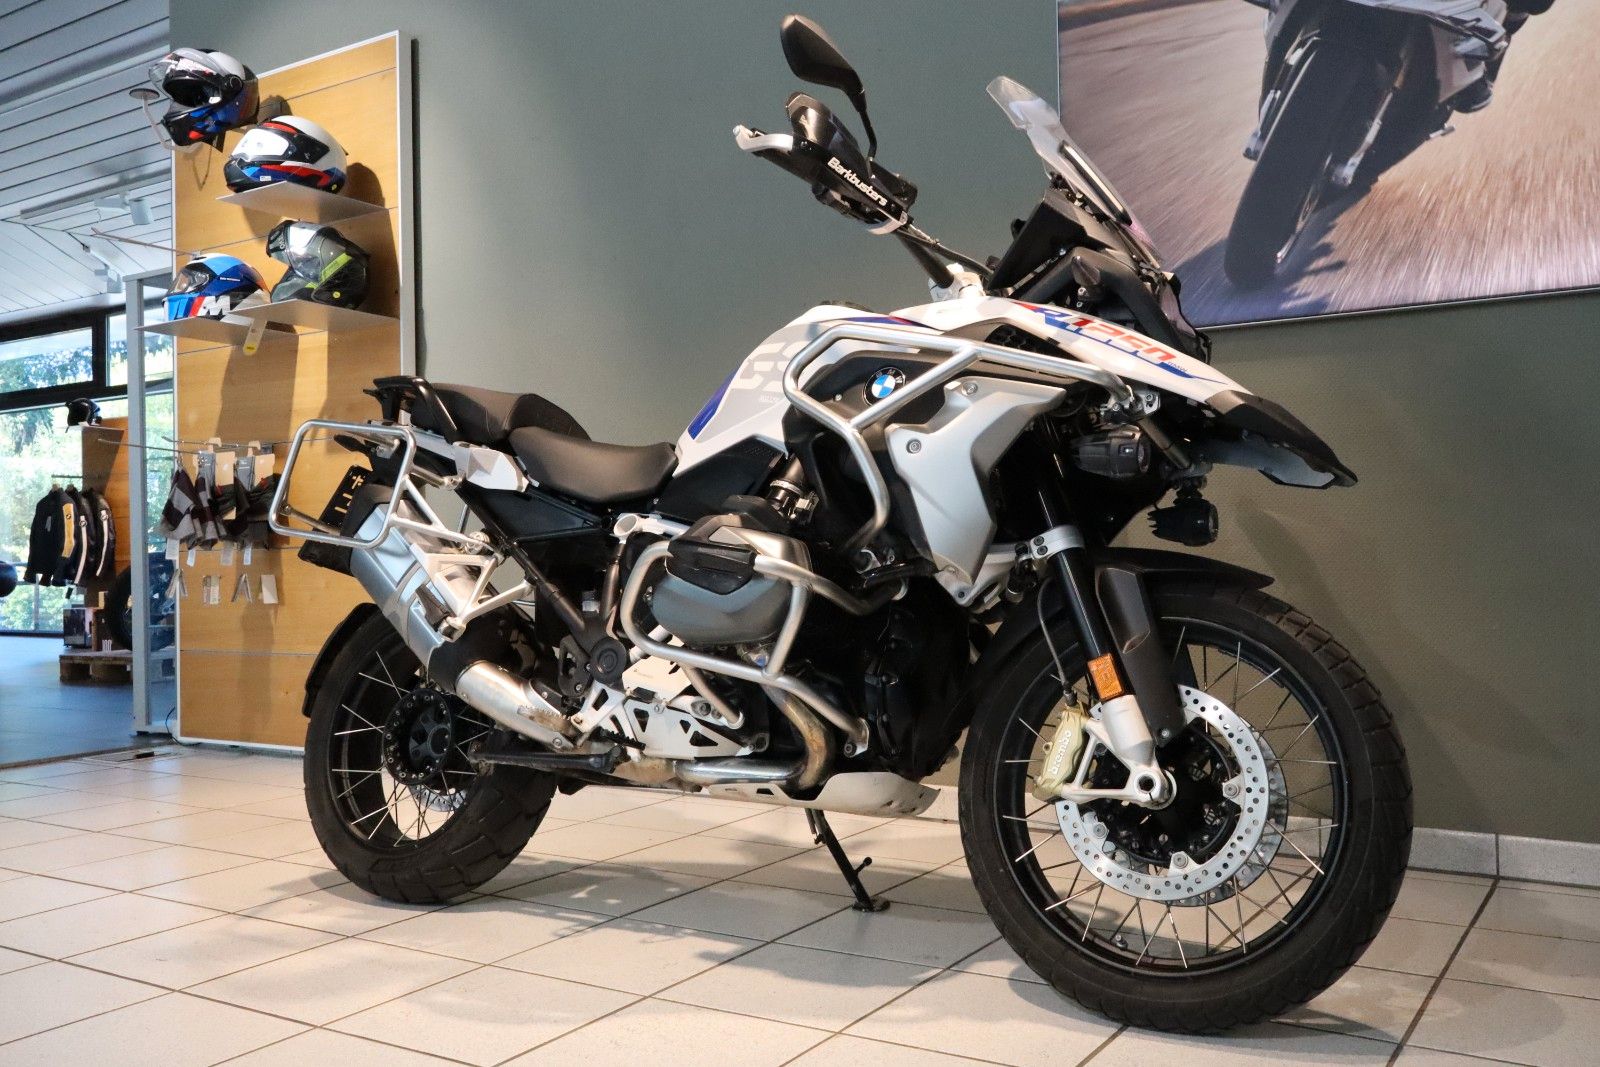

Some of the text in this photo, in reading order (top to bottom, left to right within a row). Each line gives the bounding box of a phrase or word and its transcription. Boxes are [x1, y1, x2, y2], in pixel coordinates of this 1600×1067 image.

[827, 156, 888, 206] Barkbusters
[197, 295, 231, 316] M
[1047, 730, 1072, 775] brembo
